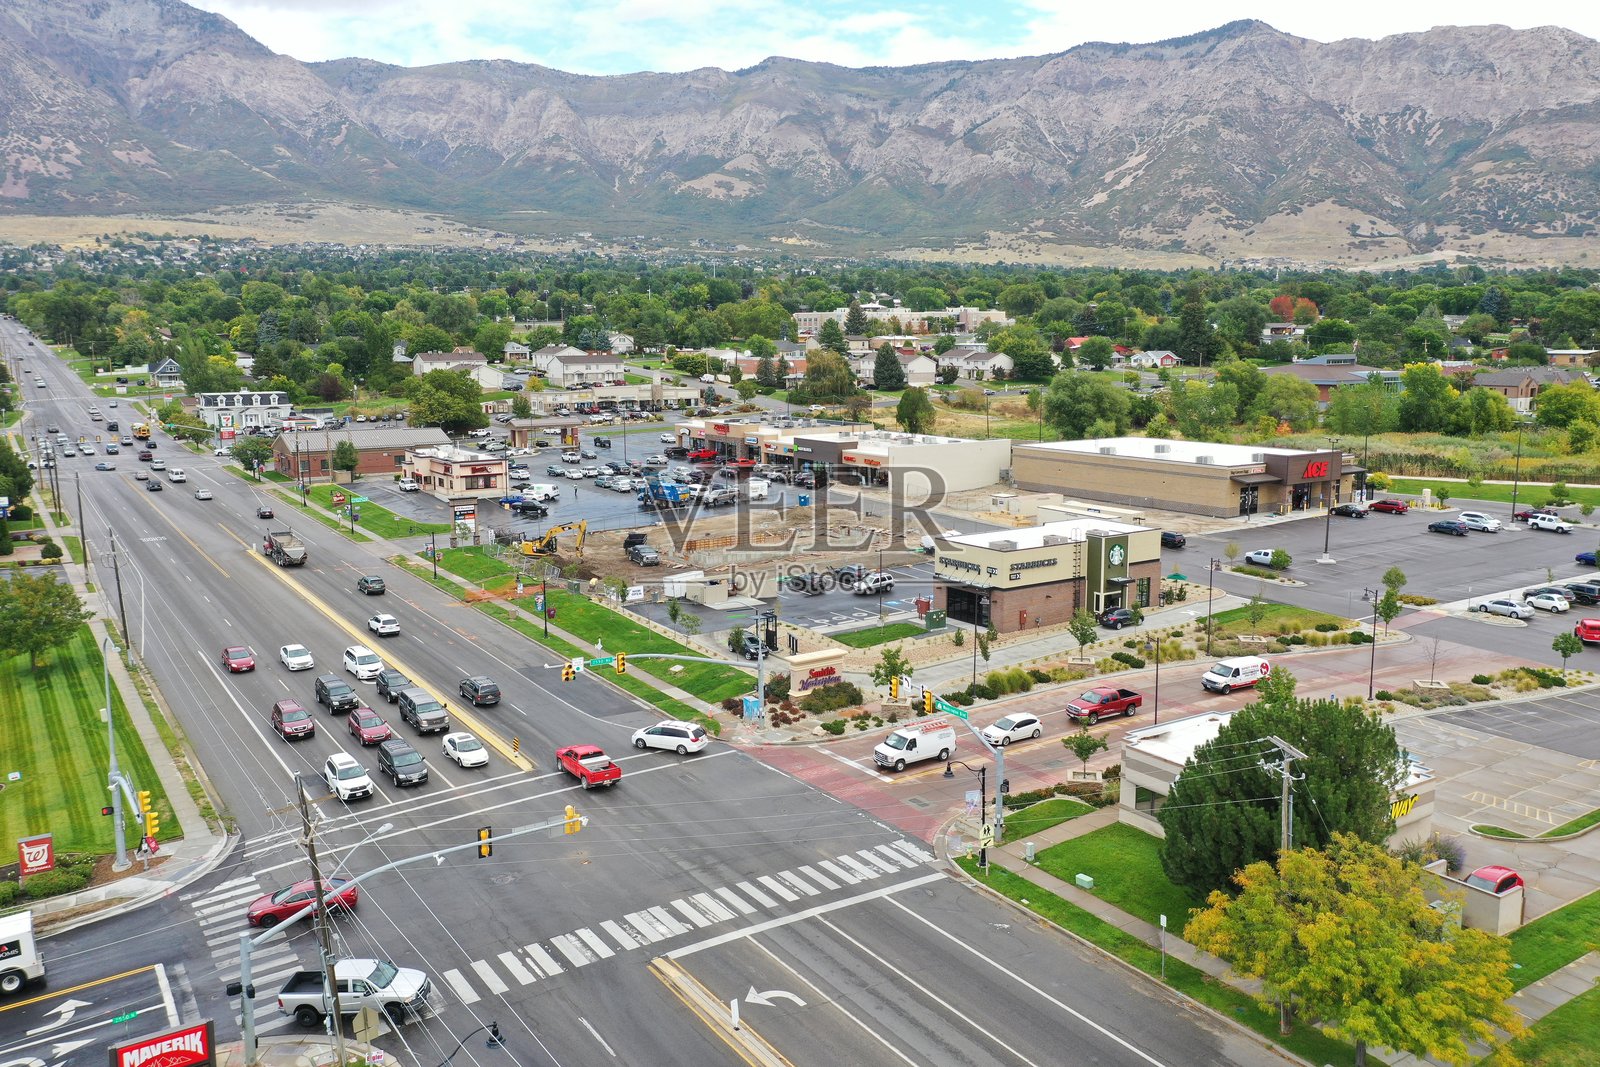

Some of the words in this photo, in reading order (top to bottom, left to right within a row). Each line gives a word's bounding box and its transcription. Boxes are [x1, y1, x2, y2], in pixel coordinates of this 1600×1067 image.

[1302, 461, 1329, 479] ACE
[939, 557, 980, 572] STARBUCKS
[1010, 558, 1057, 571] STARBUCKS
[809, 666, 836, 679] Smith's
[798, 676, 841, 691] Marketplace
[1391, 794, 1419, 819] WAY
[24, 865, 52, 873] Walgreens
[0, 949, 19, 958] OMIS
[123, 1031, 204, 1067] MAVERIK
